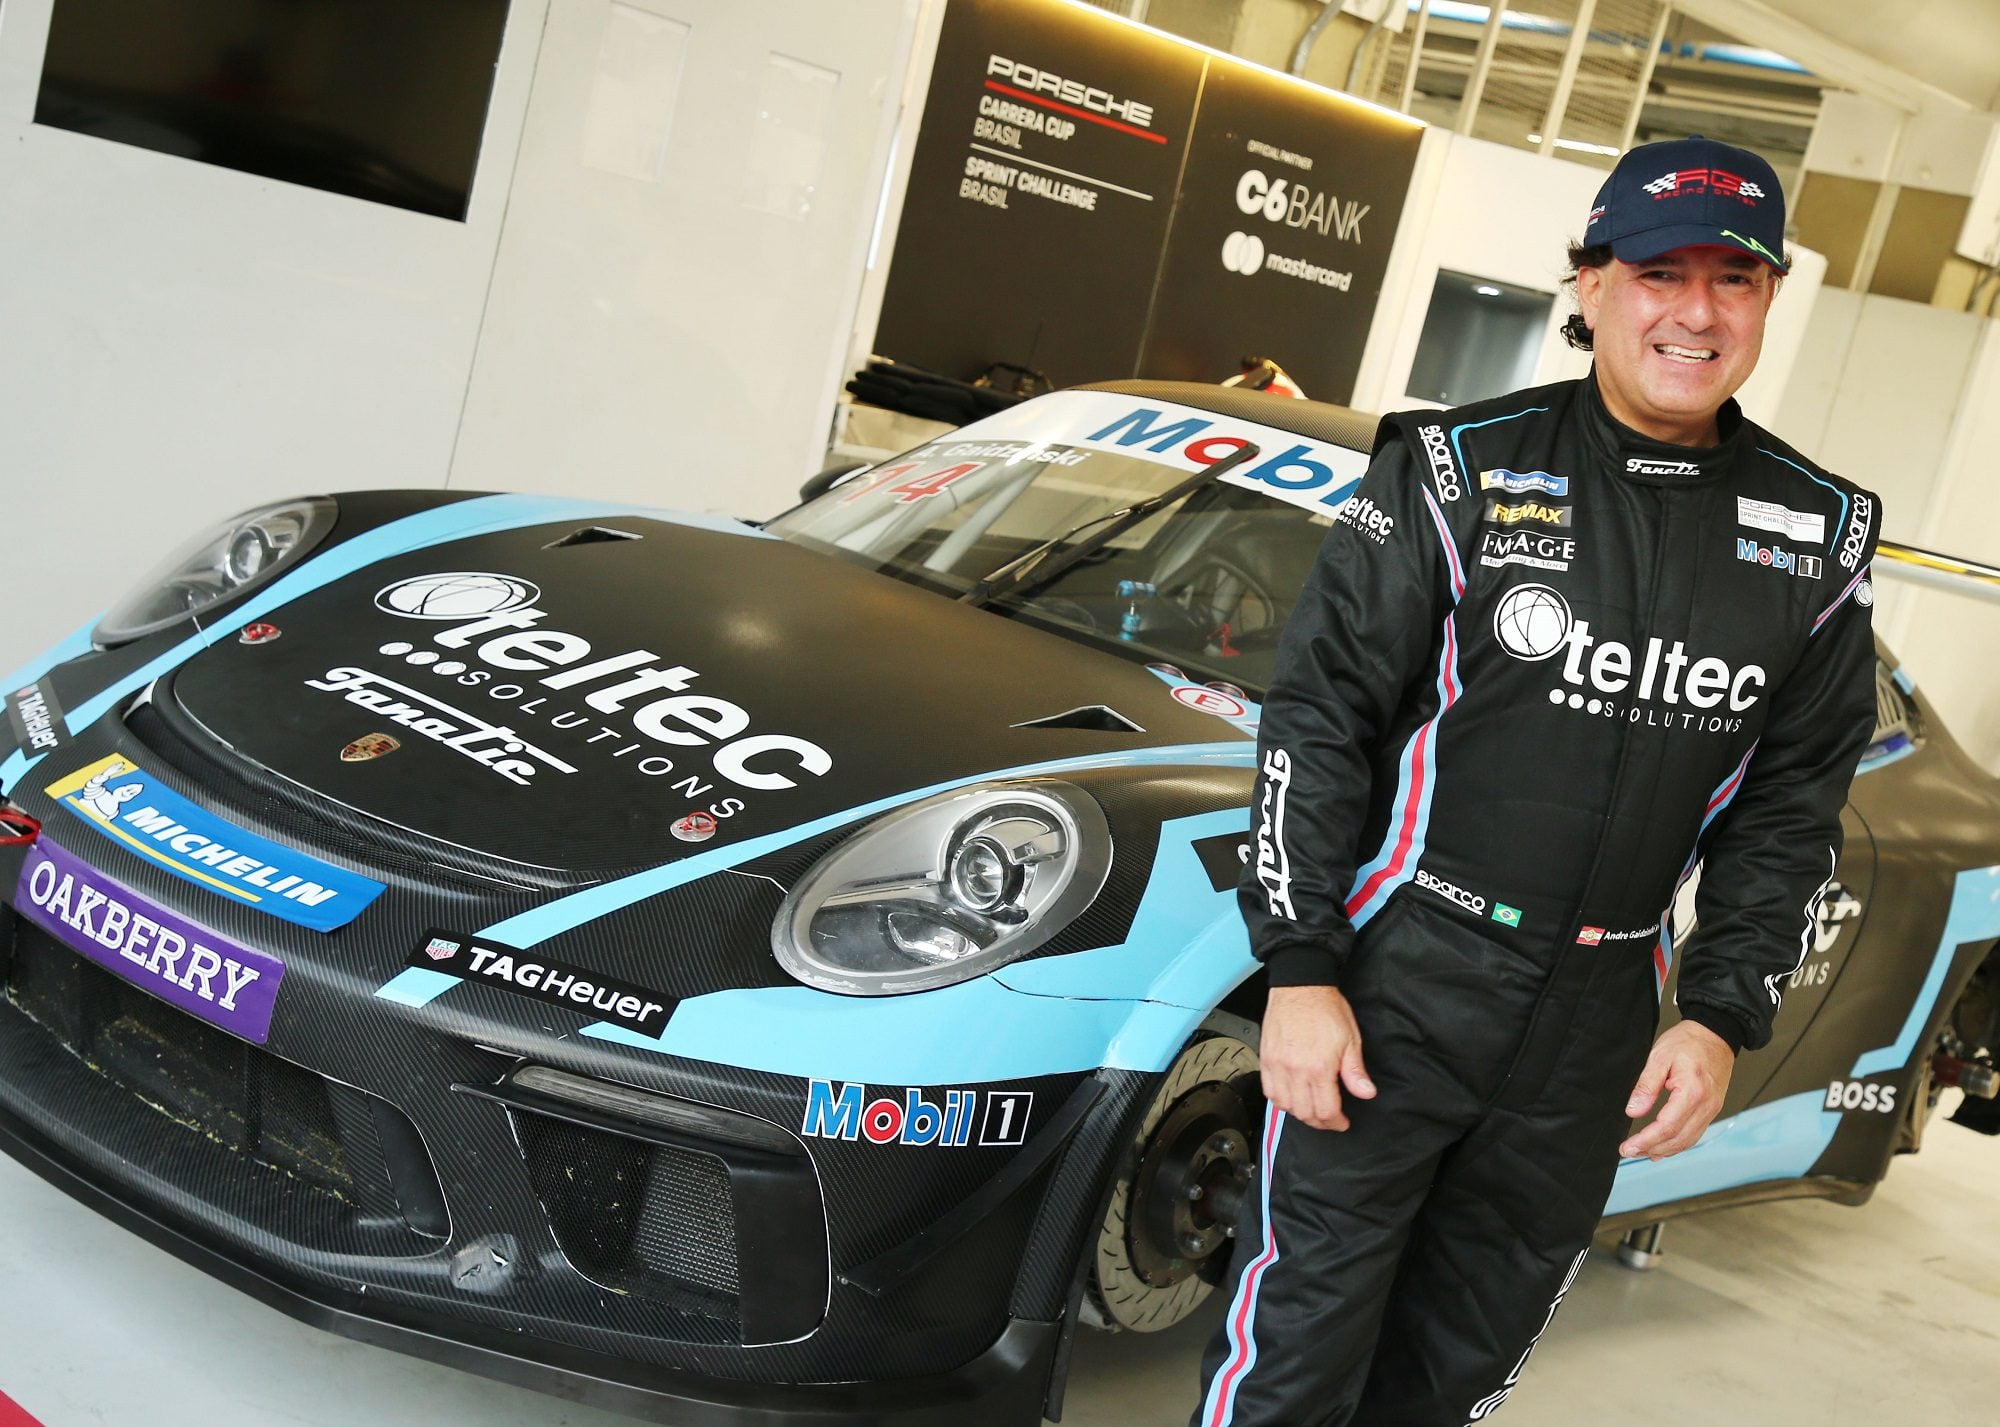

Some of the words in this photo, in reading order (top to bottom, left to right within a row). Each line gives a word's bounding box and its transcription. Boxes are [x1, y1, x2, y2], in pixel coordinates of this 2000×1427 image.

[979, 95, 1044, 133] CARRERA
[1045, 115, 1075, 141] CUP
[987, 54, 1154, 127] PORSCHE
[973, 117, 1022, 149] BRASIL
[959, 178, 1008, 209] BRASIL
[964, 156, 1019, 187] SPRINT
[1017, 171, 1098, 211] CHALLENGE
[1265, 253, 1352, 292] mastercard
[1419, 425, 1460, 502] sparco
[1626, 458, 1700, 475] Fanatic
[1342, 497, 1394, 536] eltec
[1740, 499, 1812, 521] PORSCHE
[1840, 493, 1871, 572] sparco
[1561, 619, 1766, 713] teltec
[304, 666, 578, 786] Fanatic
[433, 607, 833, 790] teltec
[1603, 700, 1742, 733] SOLUTIONS
[457, 670, 746, 819] SOLUTIONS
[123, 806, 338, 908] MICHELIN
[1415, 868, 1486, 914] sparco
[29, 861, 260, 1013] OAKBERRY
[801, 1077, 976, 1147] Mobil
[1825, 1080, 1897, 1114] BOSS
